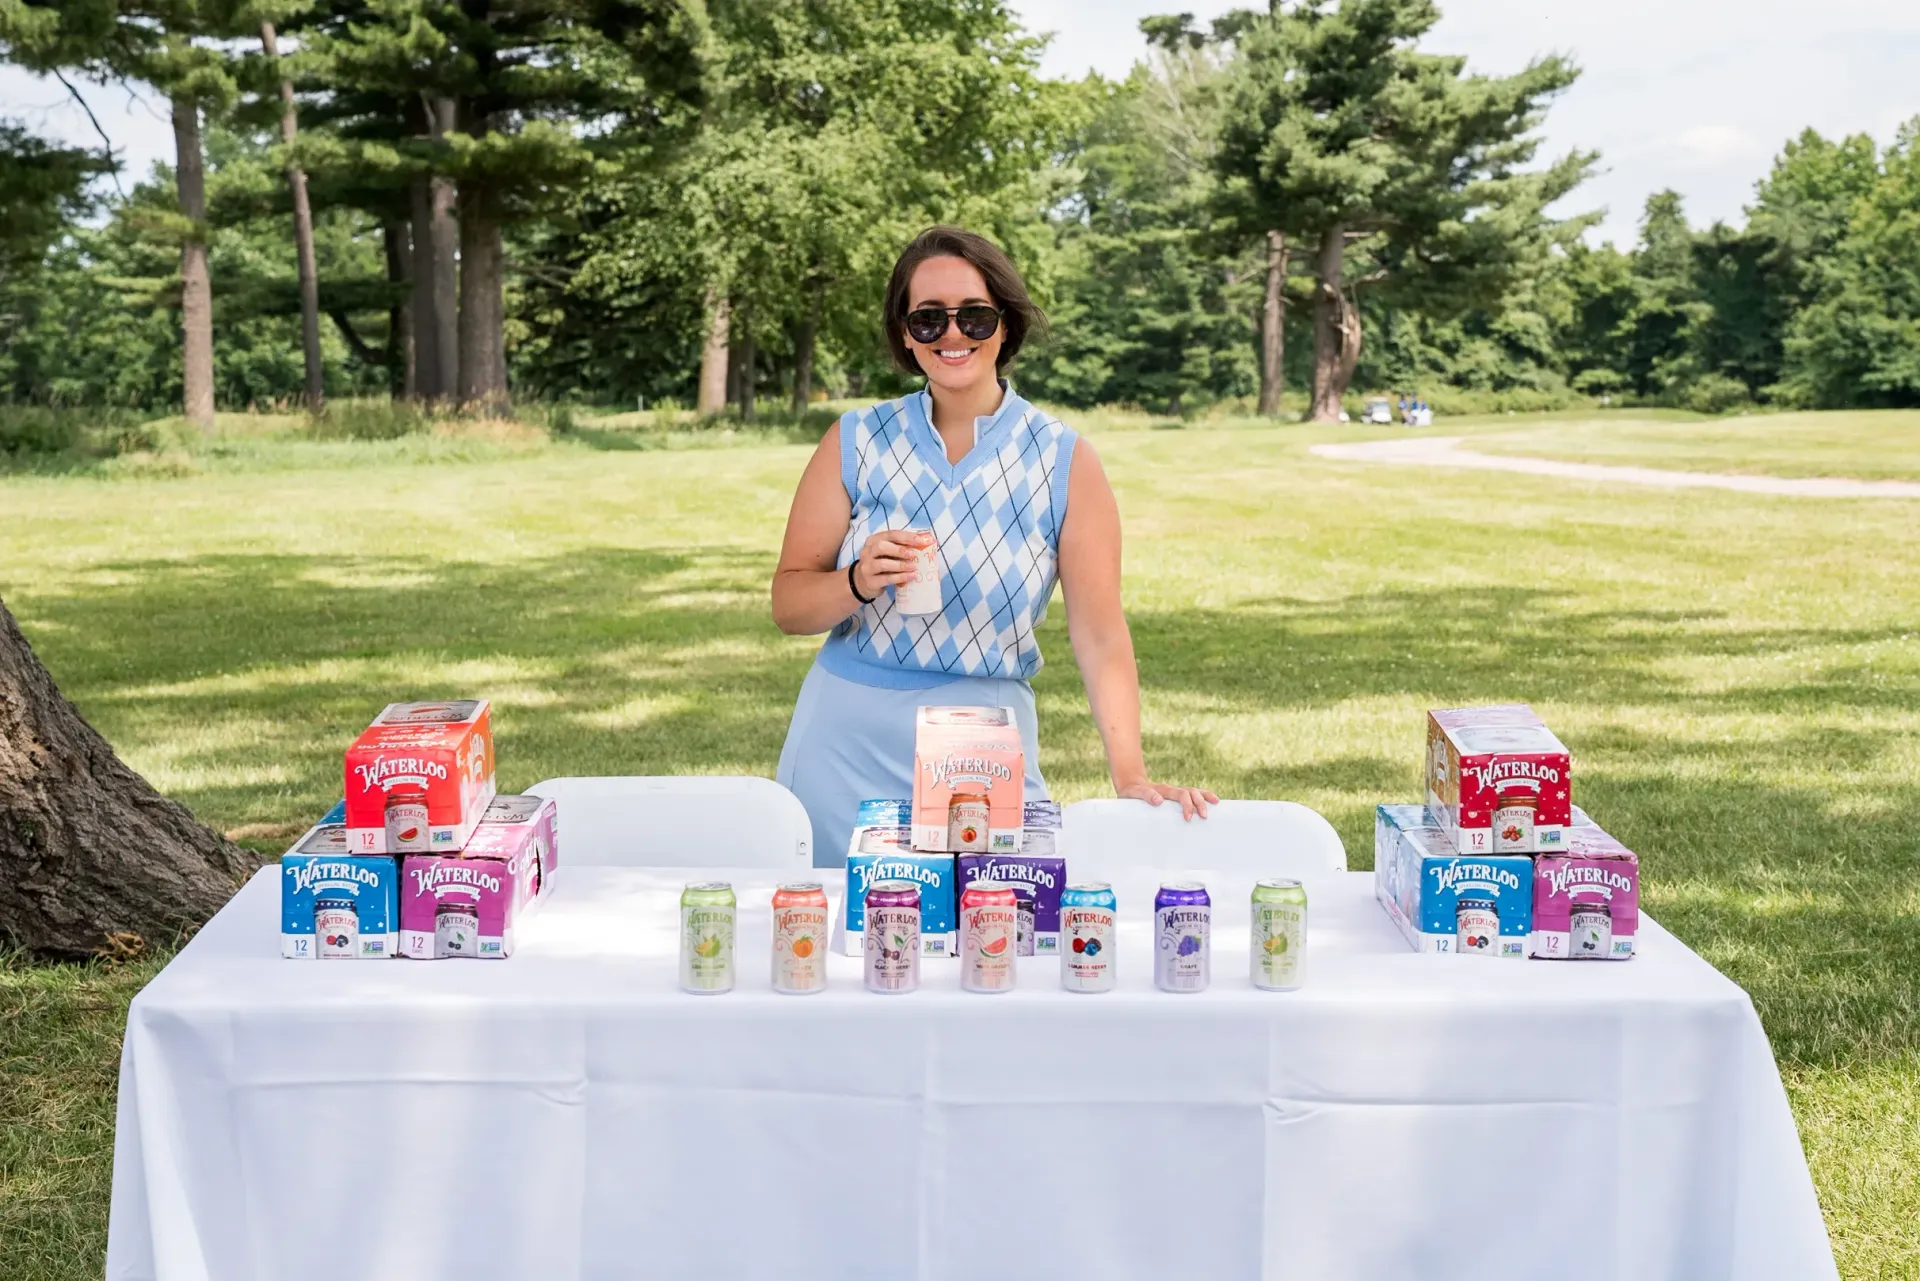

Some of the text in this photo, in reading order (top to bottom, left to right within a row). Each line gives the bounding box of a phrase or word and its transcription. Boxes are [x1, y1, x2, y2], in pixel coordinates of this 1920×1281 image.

[354, 754, 447, 793] WATERLOO
[924, 753, 1011, 790] WATERLOO
[1469, 757, 1559, 794] WATERLOO
[361, 833, 375, 845] 12
[927, 830, 939, 843] 12
[1471, 833, 1484, 845] 12
[286, 858, 379, 895] WATERLOO
[410, 861, 499, 897] WATERLOO
[853, 857, 941, 896] WATERLOO
[966, 858, 1055, 890] WATERLOO
[1429, 859, 1519, 895] WATERLOO
[1543, 862, 1631, 898] WATERLOO
[868, 909, 917, 931] WATERLOO
[966, 909, 1014, 931] WATERLO
[1063, 909, 1112, 930] WATERLOO
[294, 939, 308, 951] 12
[411, 936, 424, 949] 12
[1436, 939, 1449, 952] 12
[1546, 936, 1559, 949] 12
